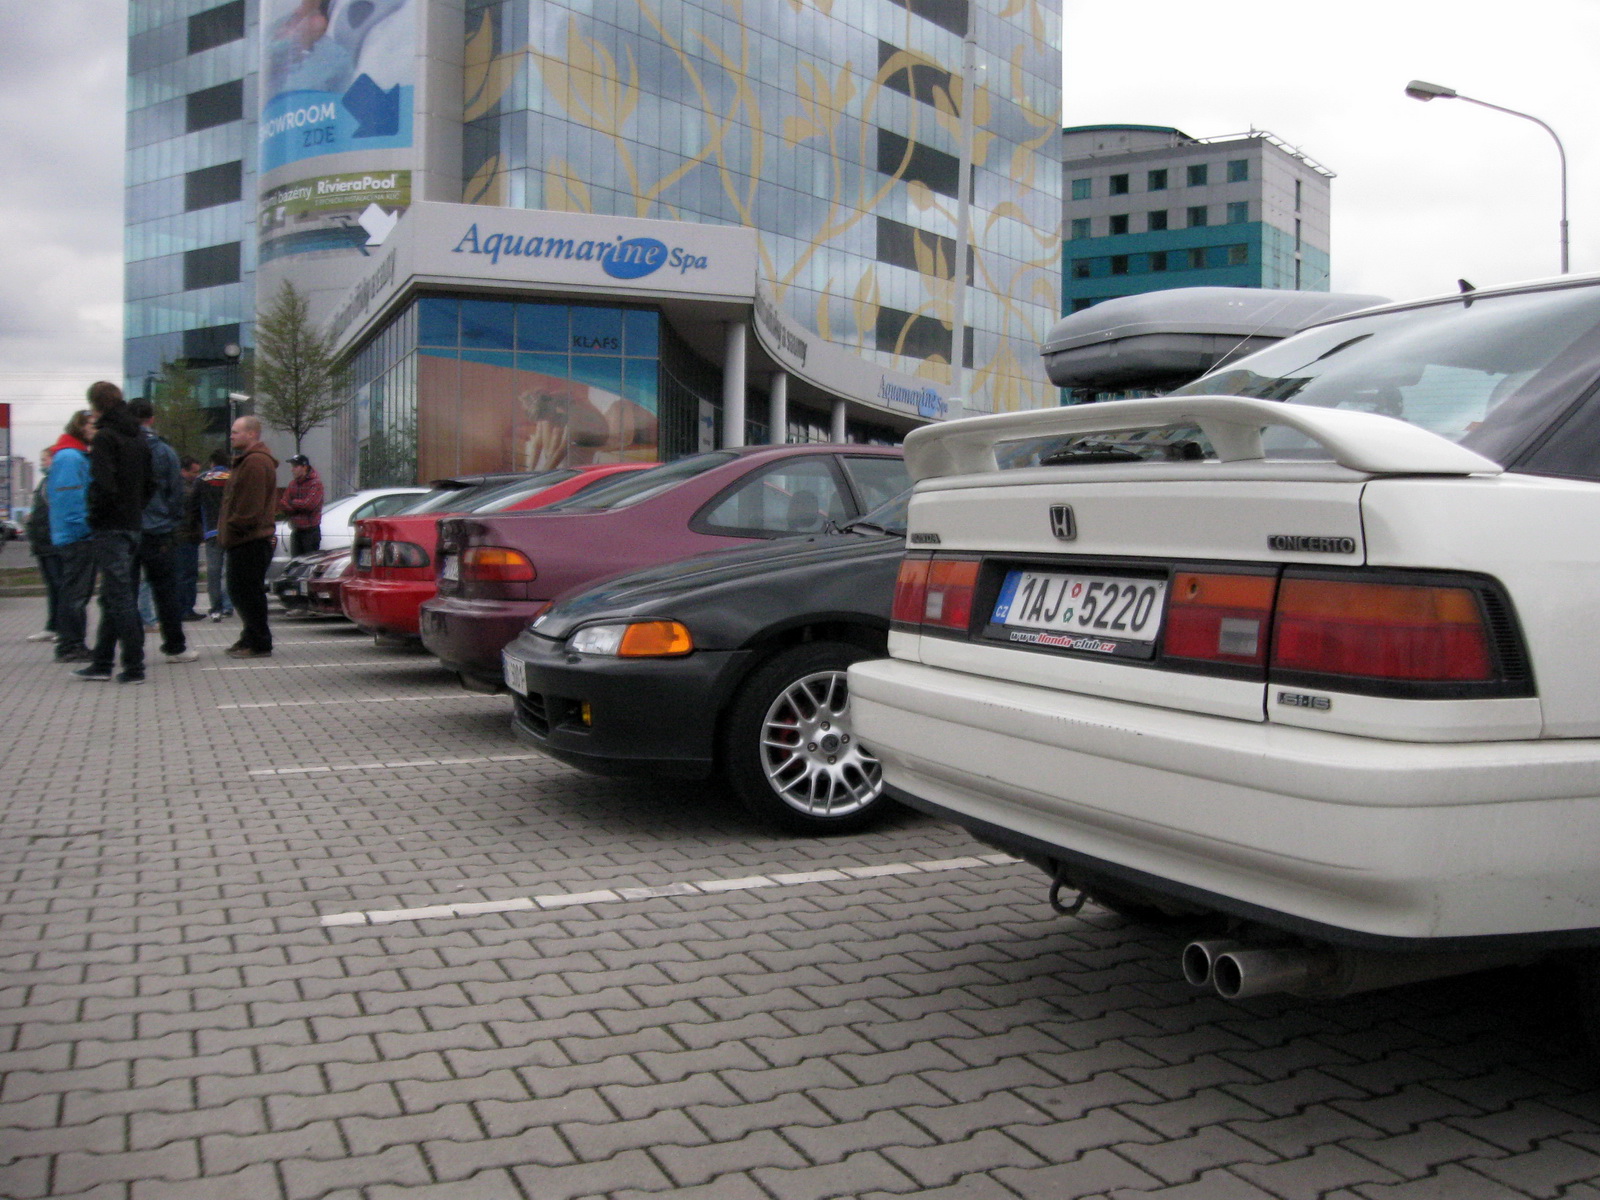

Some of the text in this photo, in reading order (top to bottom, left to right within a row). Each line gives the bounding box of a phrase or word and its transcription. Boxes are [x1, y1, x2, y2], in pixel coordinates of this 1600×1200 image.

[259, 102, 336, 138] HOWROOM
[303, 126, 335, 148] ZDE
[317, 174, 396, 194] RivieraPool
[452, 222, 708, 274] Aquamarine Spa
[573, 336, 618, 349] KLAFS
[1267, 535, 1355, 554] CONCERTO
[995, 605, 1007, 618] CZ
[1019, 577, 1156, 633] 1AJ 5220
